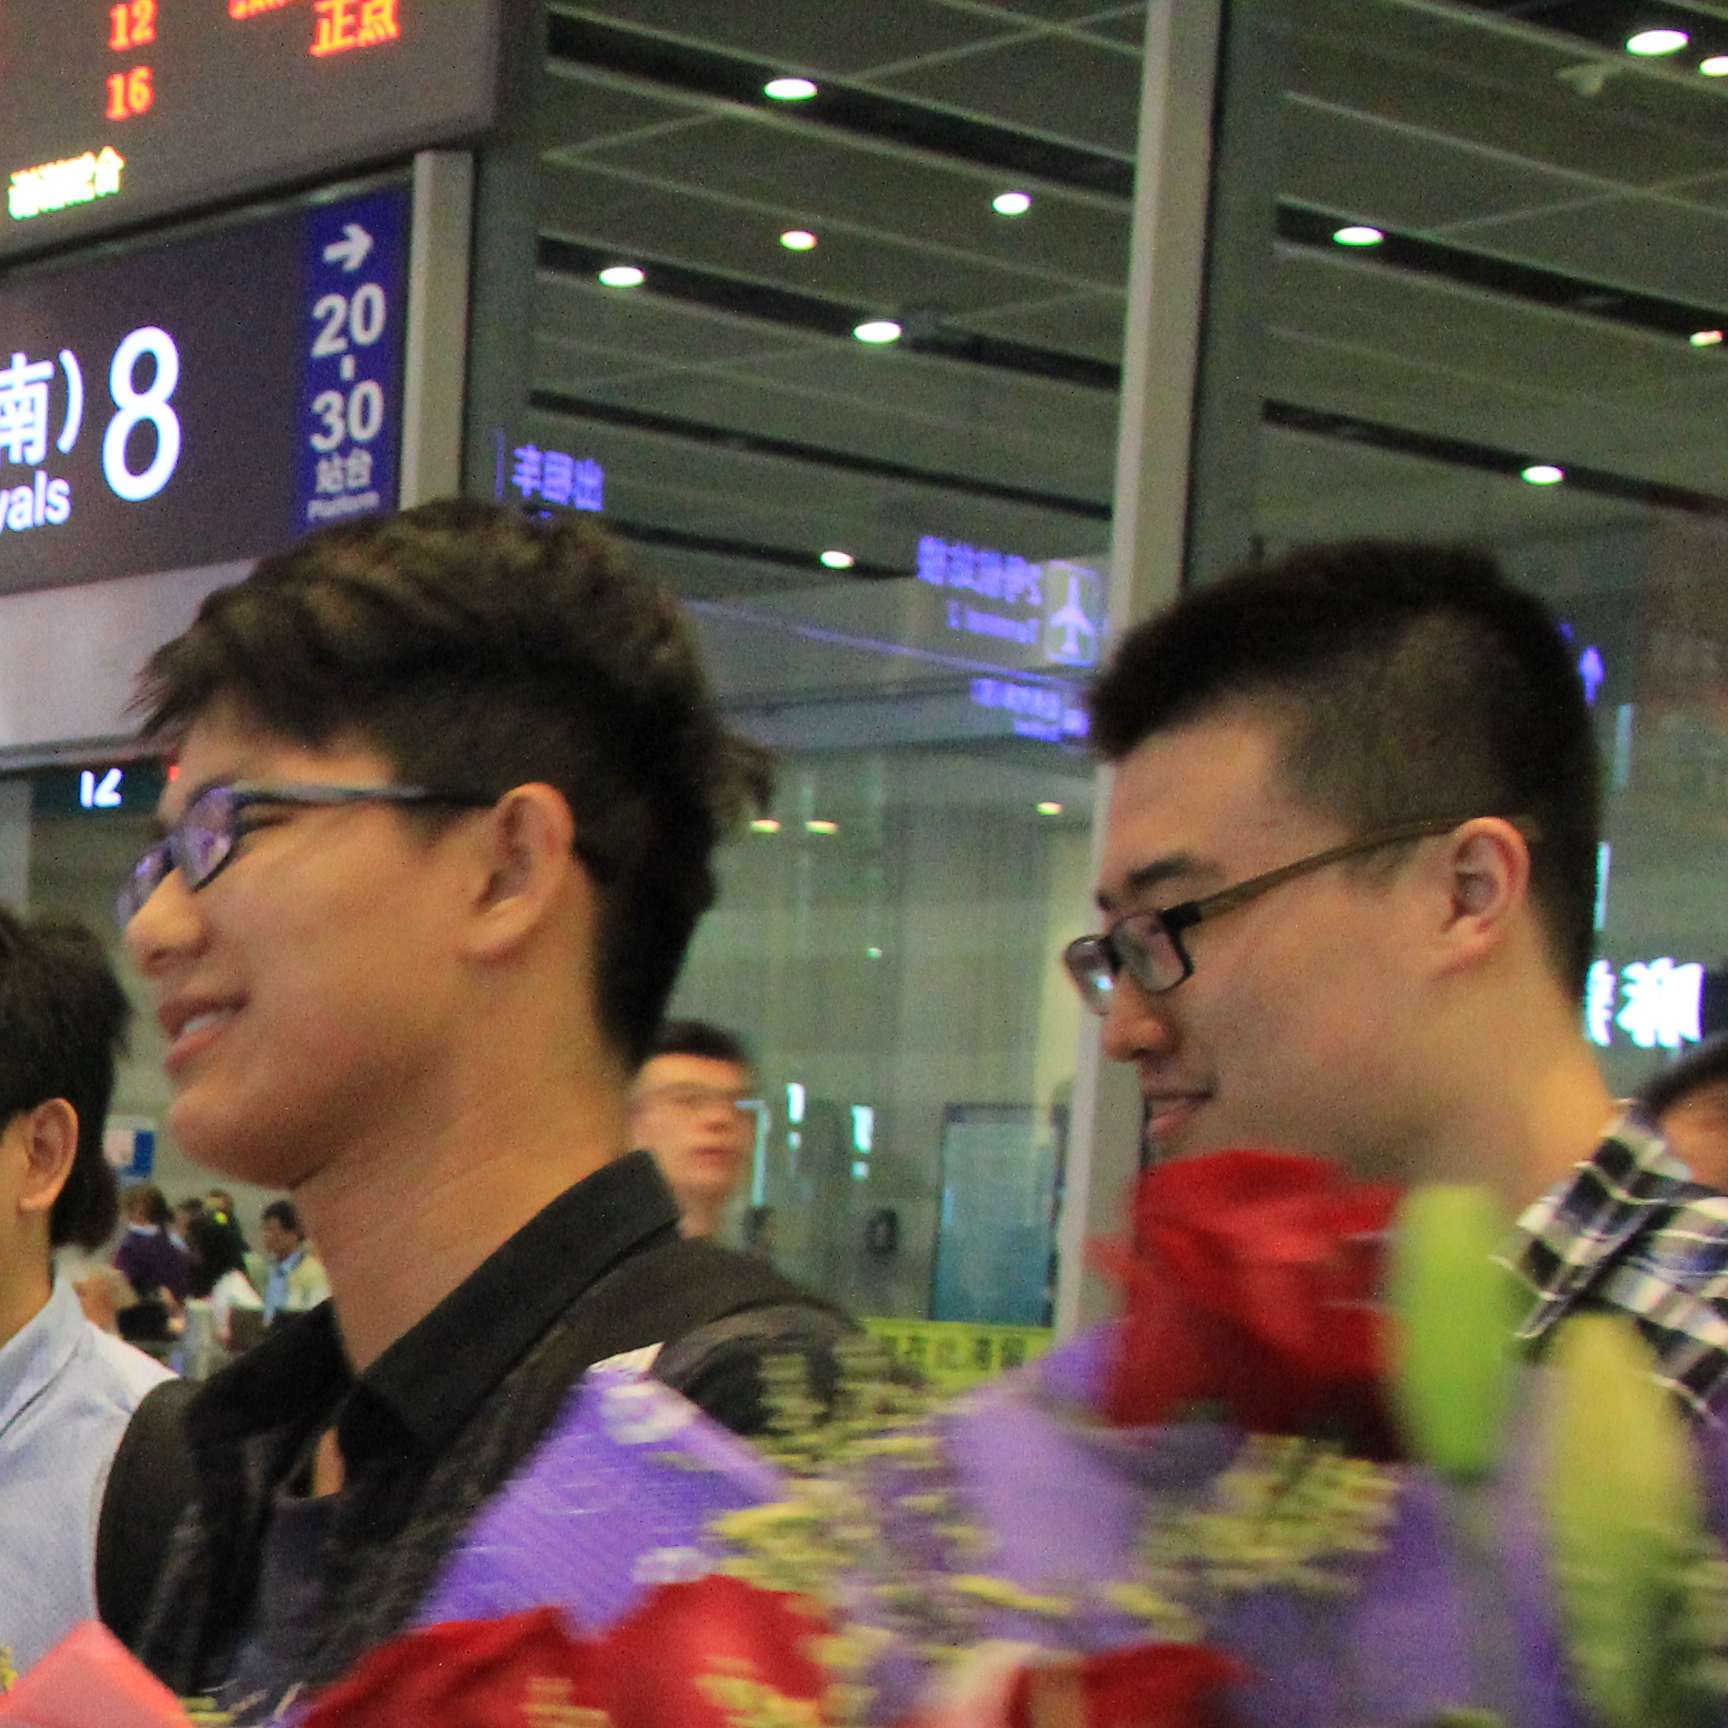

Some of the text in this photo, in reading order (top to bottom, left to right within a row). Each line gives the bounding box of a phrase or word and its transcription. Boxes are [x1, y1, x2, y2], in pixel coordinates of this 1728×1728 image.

[107, 0, 157, 51] 12
[106, 66, 154, 120] 16
[311, 282, 386, 357] 20
[102, 326, 182, 501] 8
[310, 380, 384, 452] 30
